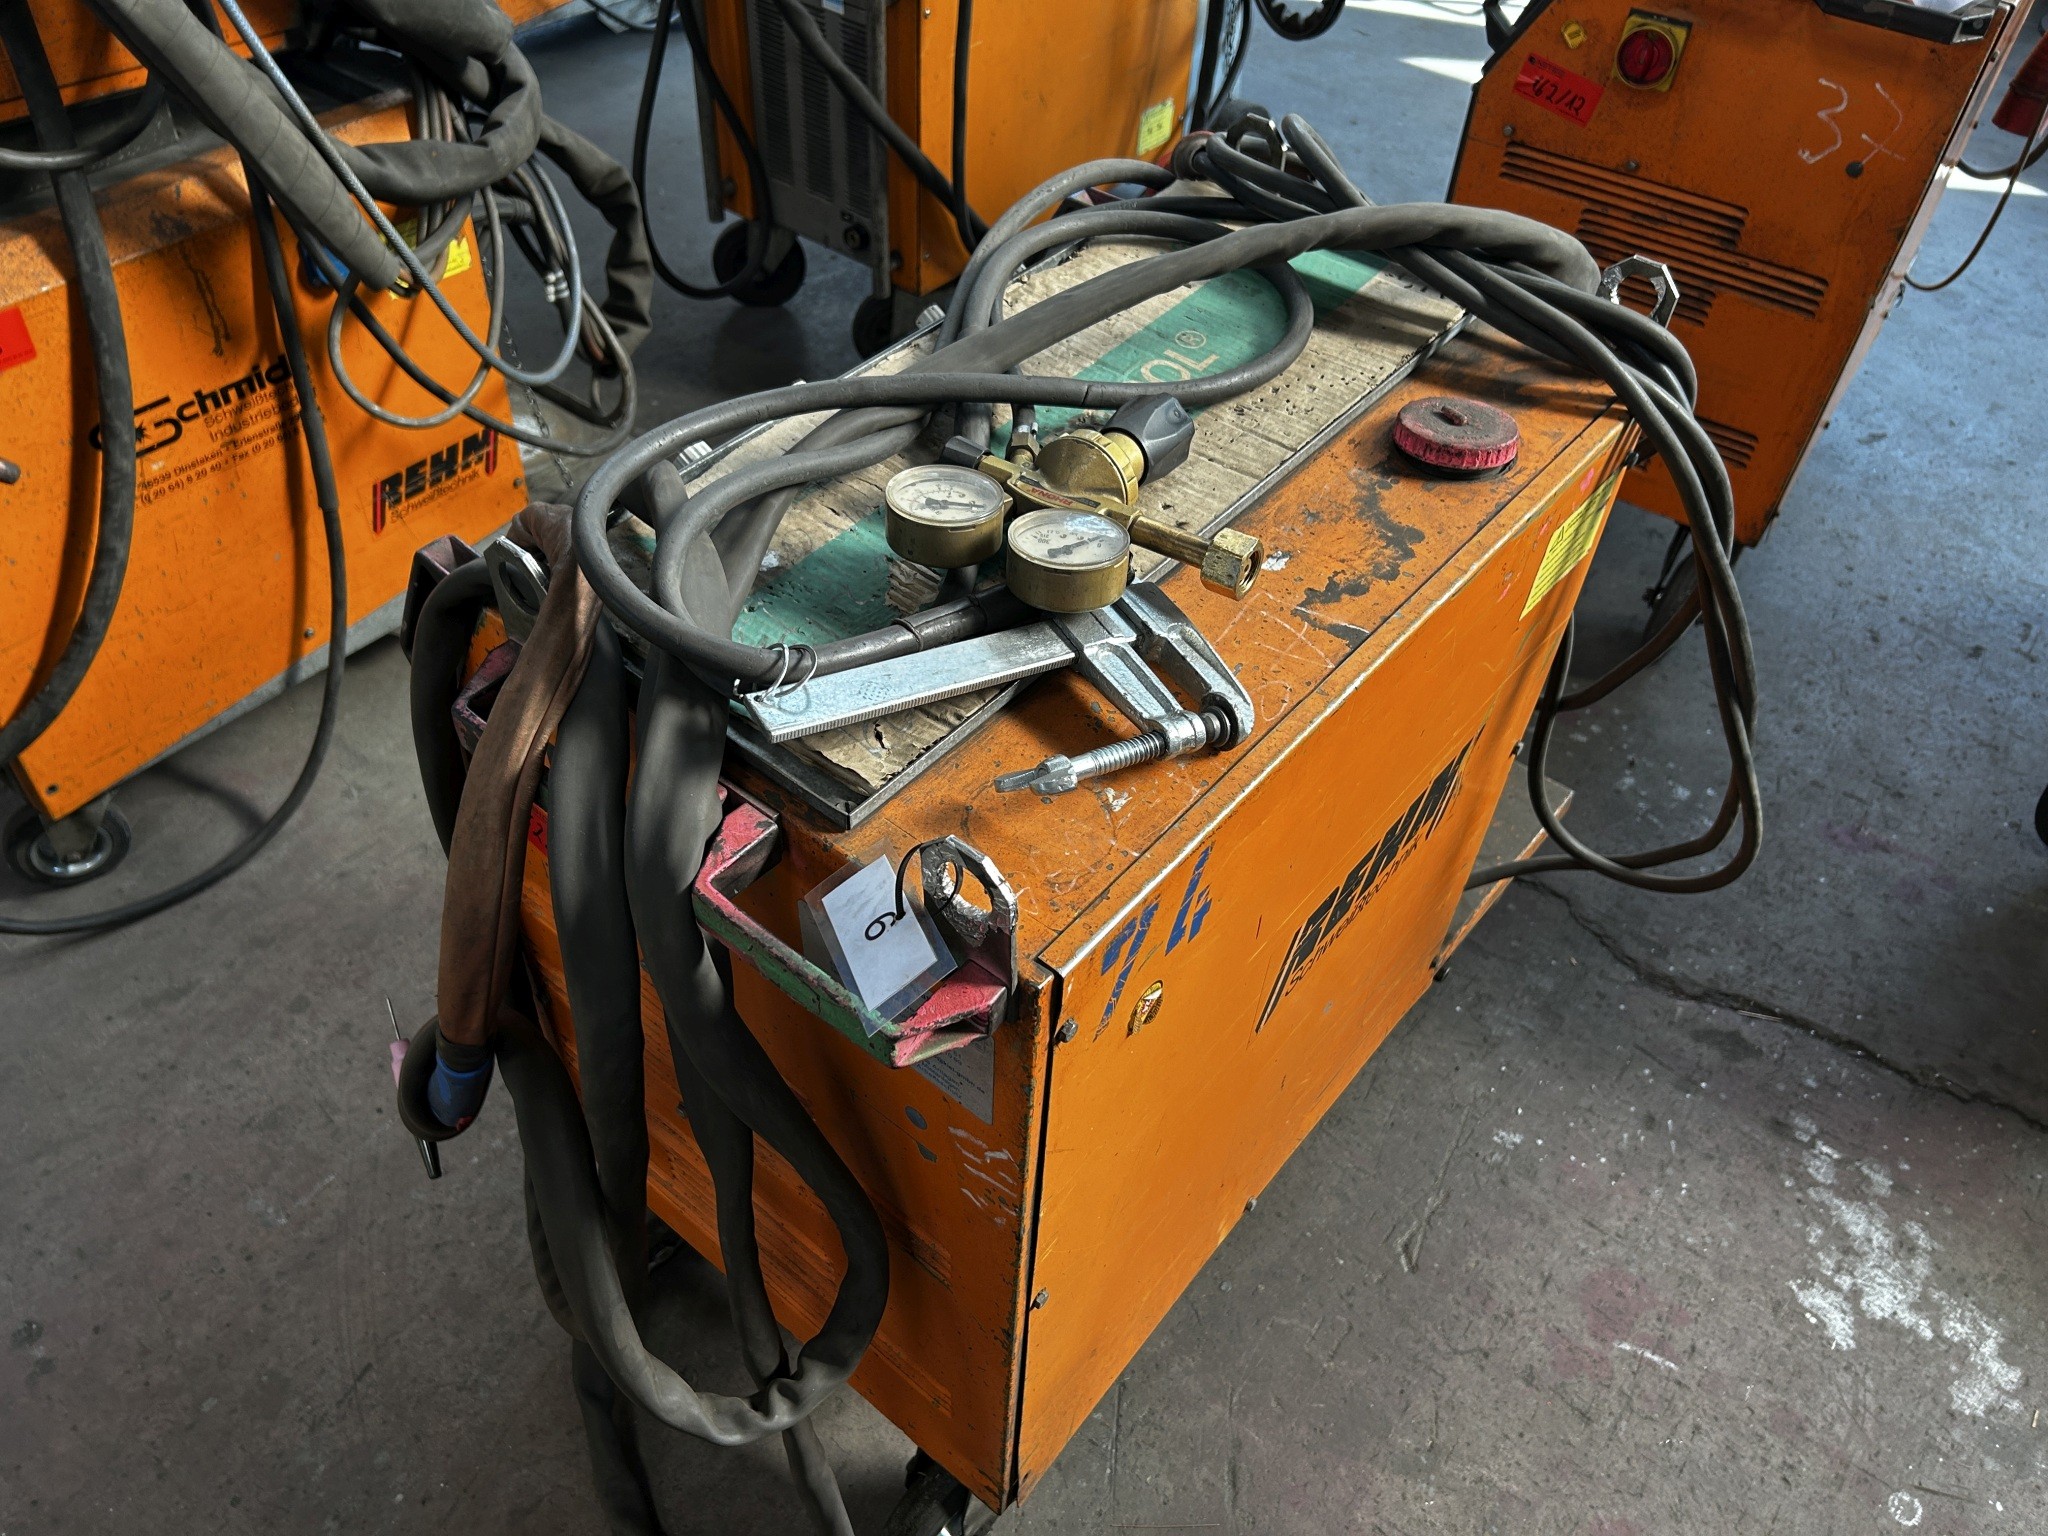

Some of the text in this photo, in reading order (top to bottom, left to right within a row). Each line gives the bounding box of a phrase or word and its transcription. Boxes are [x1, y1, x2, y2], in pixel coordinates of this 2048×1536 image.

[89, 354, 293, 458] Schmid
[375, 427, 497, 518] REHM
[1278, 735, 1477, 985] REHM
[1283, 832, 1424, 998] Schweißtechnik
